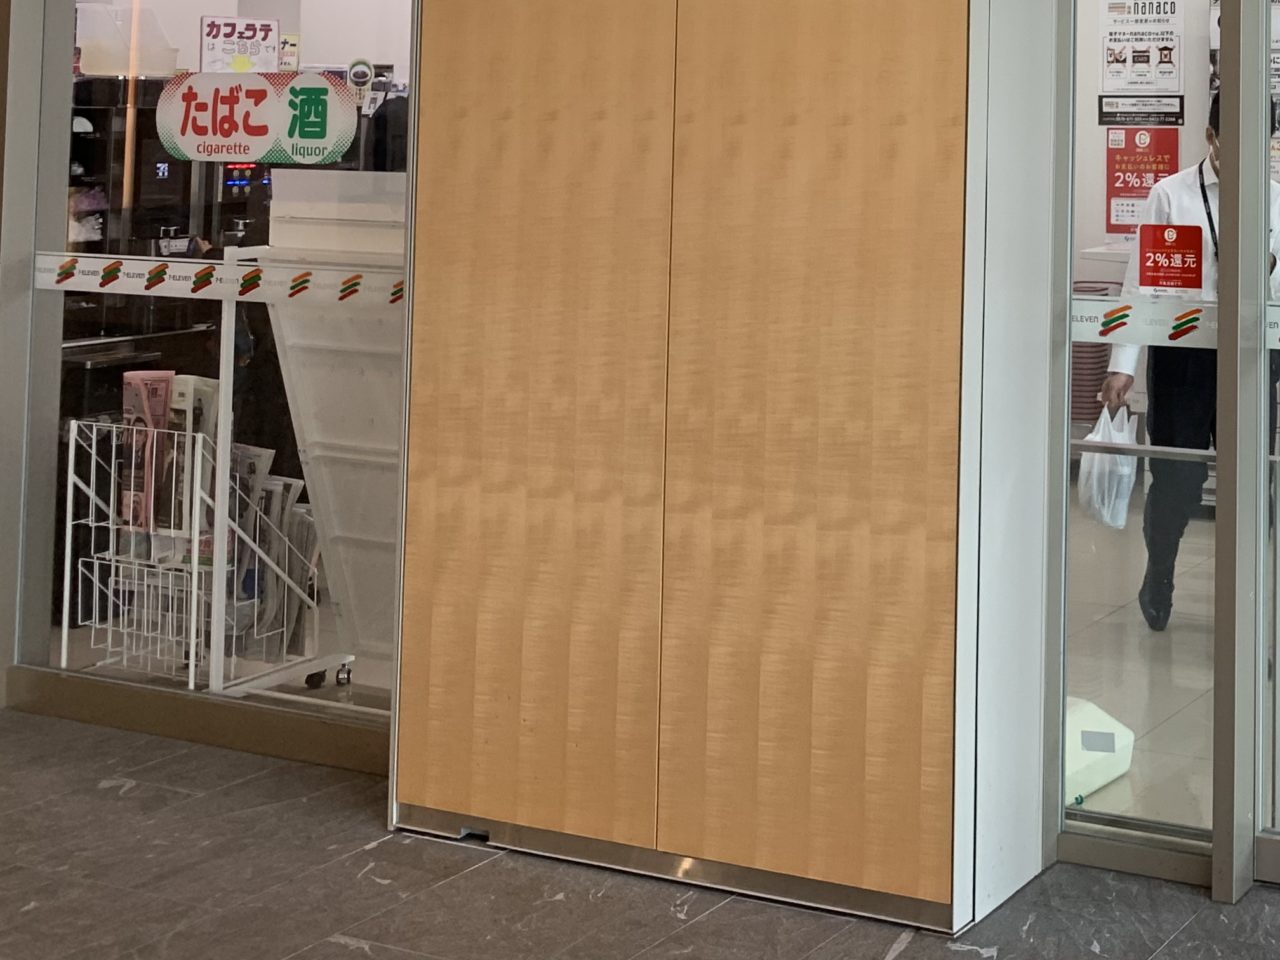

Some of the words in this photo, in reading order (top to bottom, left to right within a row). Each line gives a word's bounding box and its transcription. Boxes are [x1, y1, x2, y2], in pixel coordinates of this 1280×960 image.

[1133, 1, 1176, 15] nanaco
[205, 20, 273, 41] カフェラテ
[180, 83, 269, 139] たばこ
[288, 86, 329, 140] 酒
[196, 141, 250, 157] cigarette
[291, 143, 328, 157] liquor
[1145, 252, 1197, 268] 2%還元
